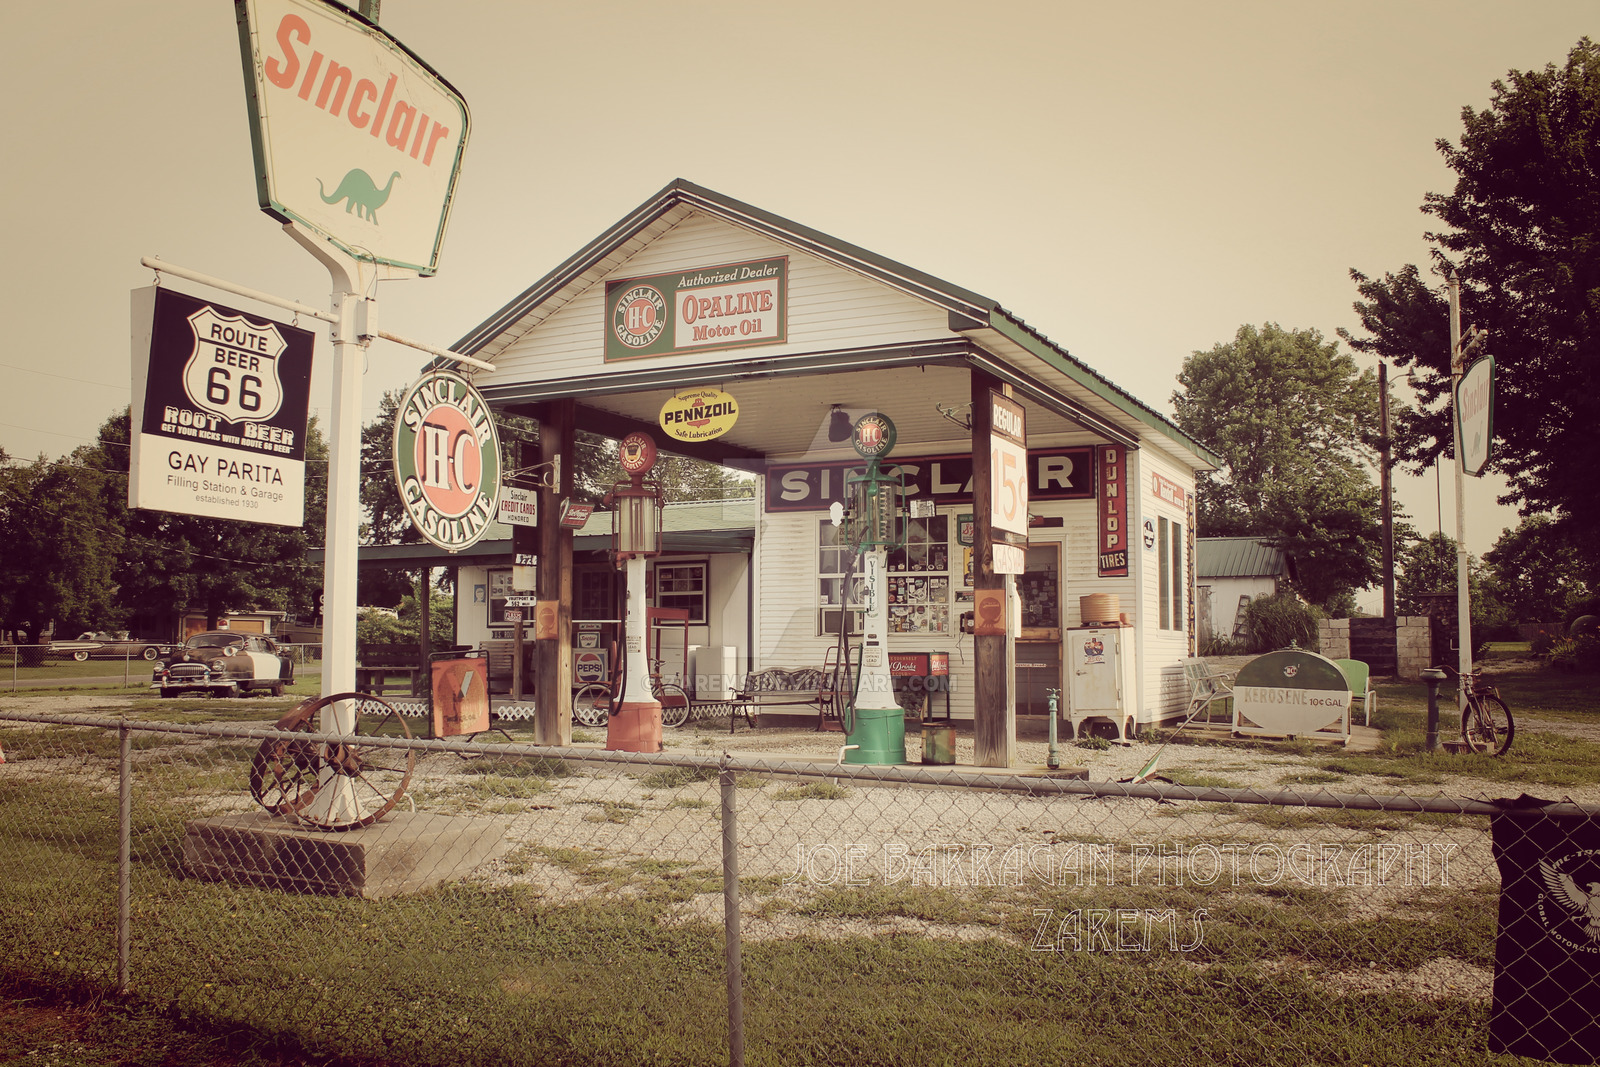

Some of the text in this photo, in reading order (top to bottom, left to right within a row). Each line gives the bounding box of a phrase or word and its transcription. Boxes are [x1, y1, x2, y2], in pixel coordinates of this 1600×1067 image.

[264, 13, 449, 167] Sinclair
[677, 264, 778, 288] Authorized Dealer
[618, 288, 663, 314] SINCLAIR
[682, 289, 773, 325] OPALINE
[211, 323, 268, 352] ROUTE
[617, 319, 663, 346] GASOLINE
[692, 318, 762, 342] Motor Oil
[214, 347, 260, 372] BEER
[206, 366, 262, 412] 66
[678, 390, 718, 402] Supreme Quality
[1462, 375, 1489, 423] Sinclair
[163, 405, 295, 446] ROOT BEER
[404, 378, 492, 448] SINCLAIR
[664, 401, 736, 426] PENNZOIL
[856, 417, 887, 433] SINCLAIR
[993, 403, 1022, 439] REGULAR
[161, 423, 177, 434] GET
[177, 425, 198, 437] YOUR
[198, 429, 221, 442] KICKS
[221, 434, 240, 445] WITH
[241, 438, 263, 449] ROUTE
[621, 436, 647, 450] SINCLAIR
[674, 427, 723, 439] Safe Lubrication
[855, 436, 888, 454] GASOLINE
[168, 451, 283, 486] GAY PARITA
[621, 456, 646, 470] GASOLINE
[167, 475, 284, 503] Filling Station & Garage
[780, 455, 1074, 502] SINCLR
[195, 494, 259, 509] established 1930
[501, 500, 536, 516] CREDIT CARDS
[510, 490, 528, 502] Sinclair
[1105, 449, 1119, 549] DUNLOP
[404, 477, 493, 544] GASOLINE
[507, 515, 530, 523] HONORED
[1100, 552, 1126, 569] TIRES
[868, 560, 876, 612] VISIBLE
[577, 664, 603, 673] PEPSI
[1244, 687, 1308, 705] KEROSENE
[1537, 893, 1550, 928] GLOBAL
[1550, 928, 1600, 954] MOTORCYC
